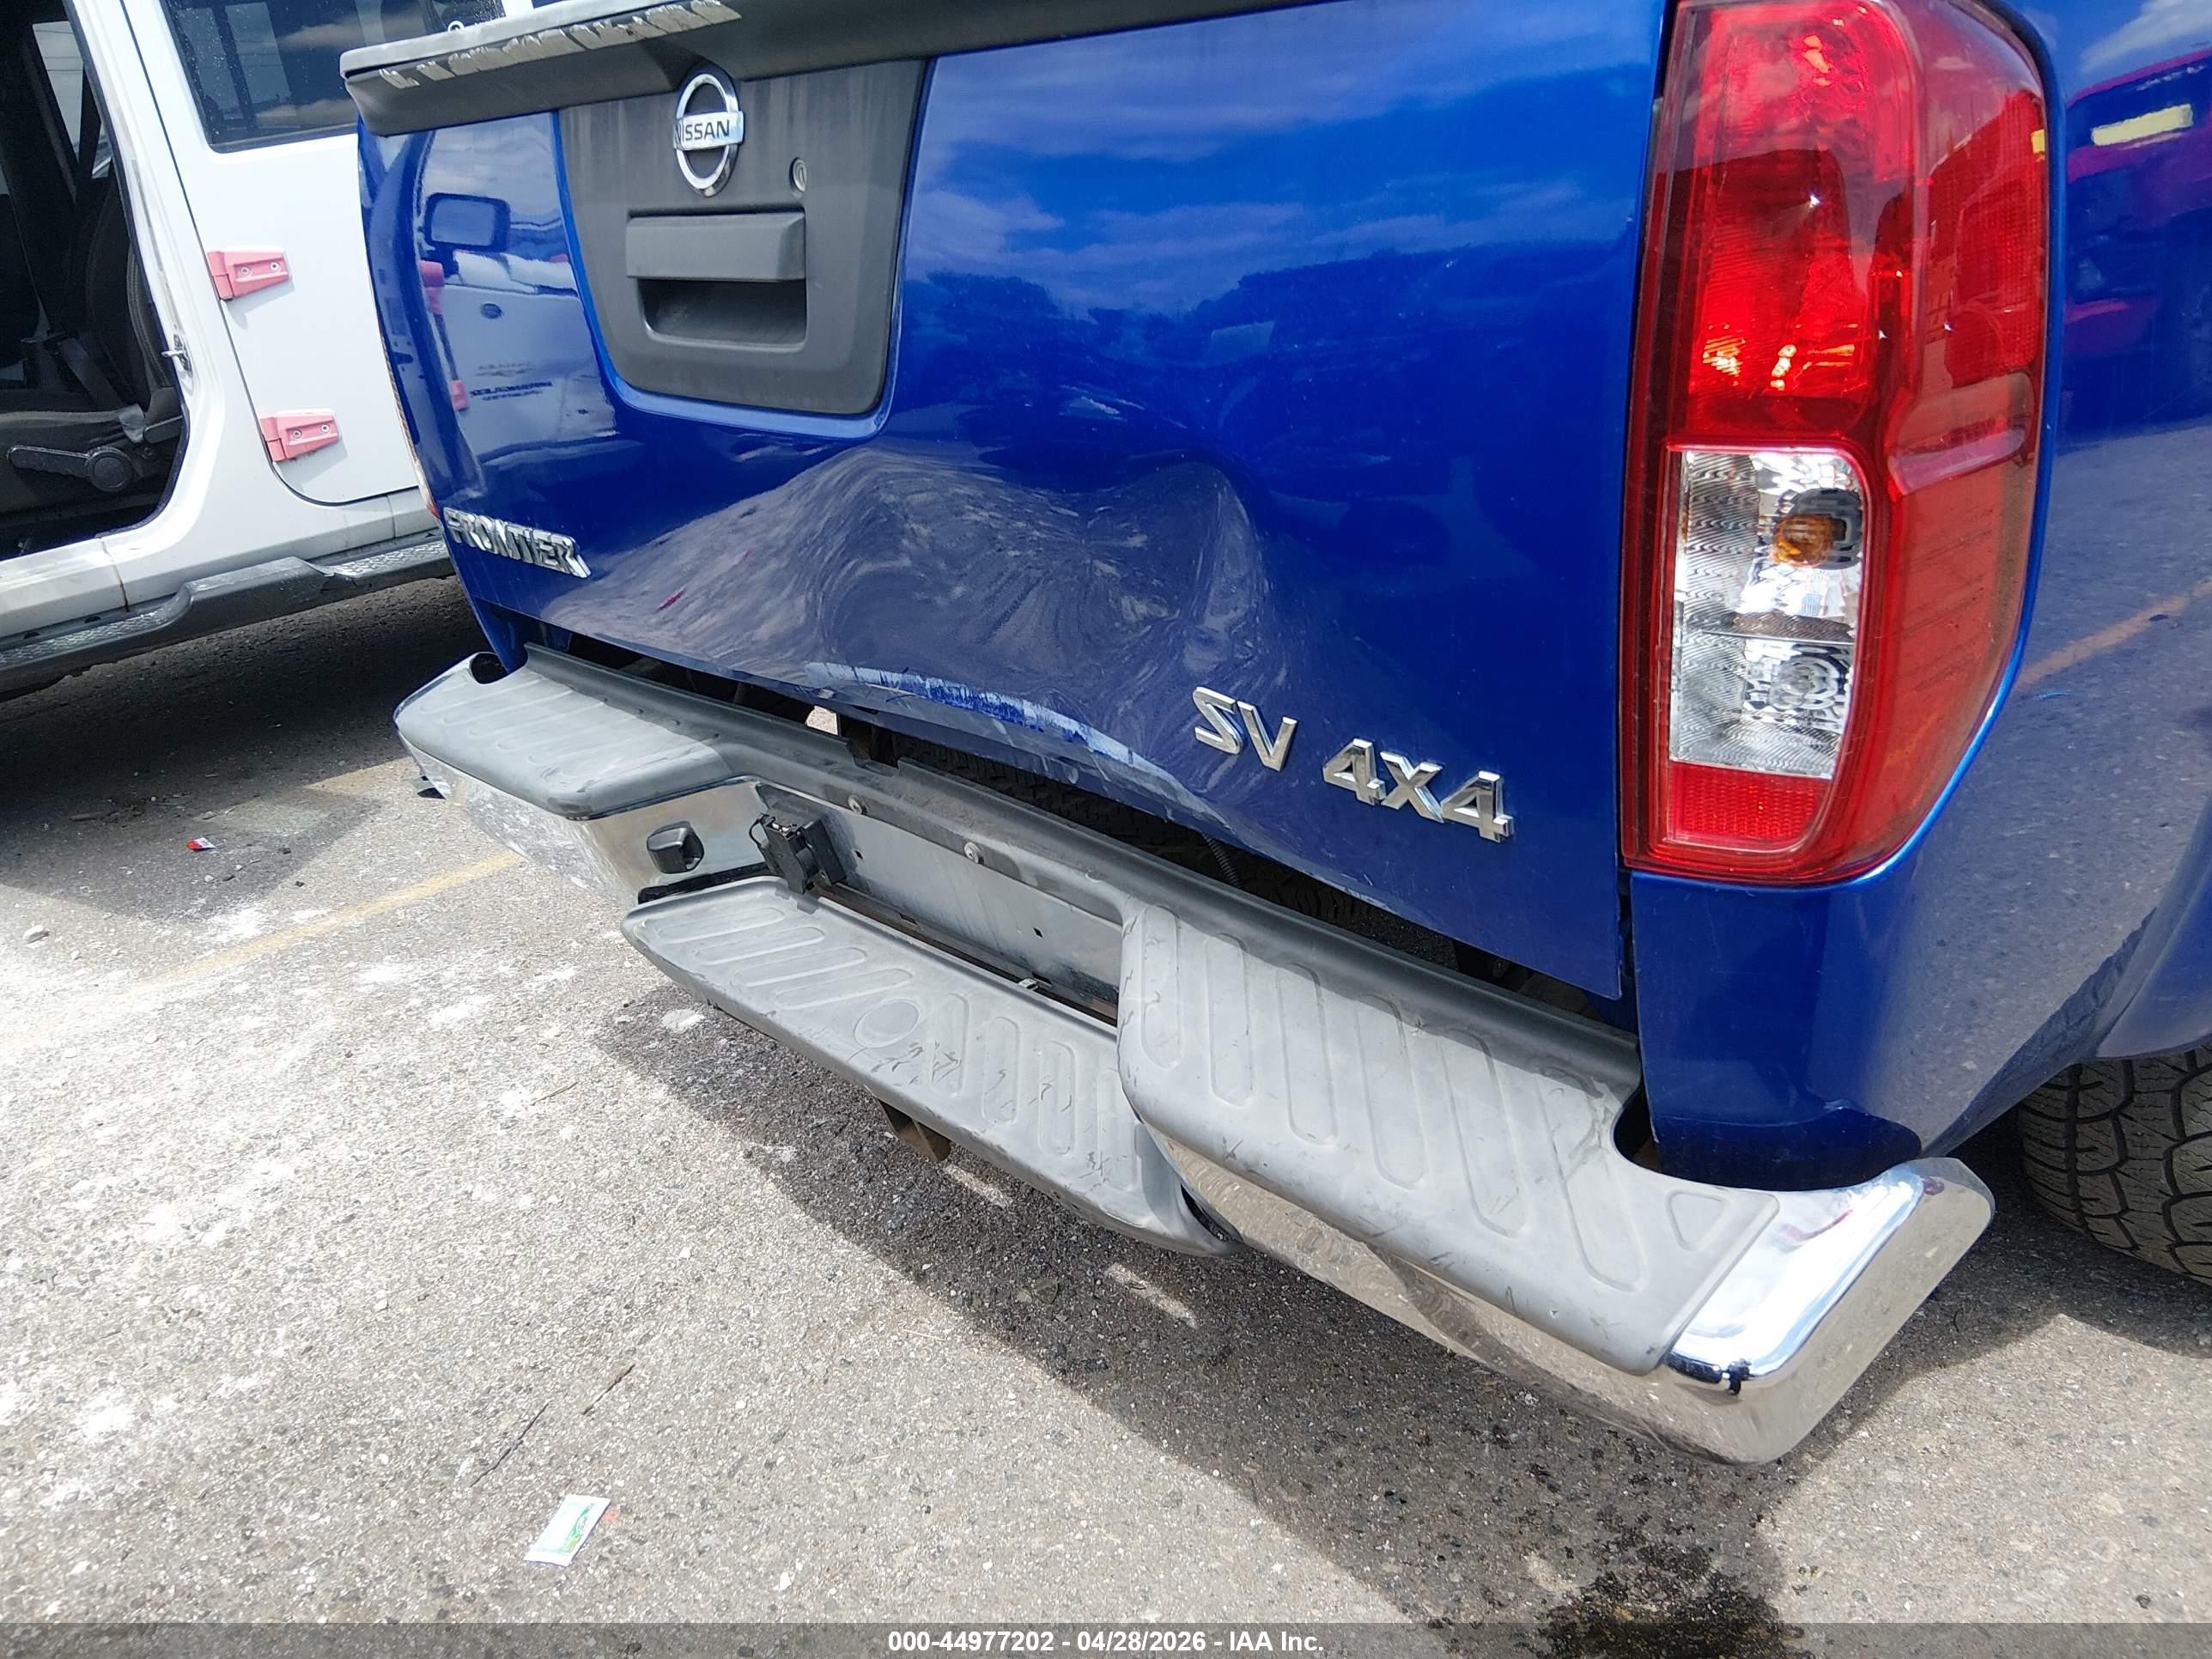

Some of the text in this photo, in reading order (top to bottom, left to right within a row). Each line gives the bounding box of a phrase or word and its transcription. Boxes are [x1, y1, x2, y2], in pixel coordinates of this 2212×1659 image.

[675, 118, 730, 143] NISSAN
[443, 507, 592, 579] FRONTIER
[1192, 686, 1298, 772] SV
